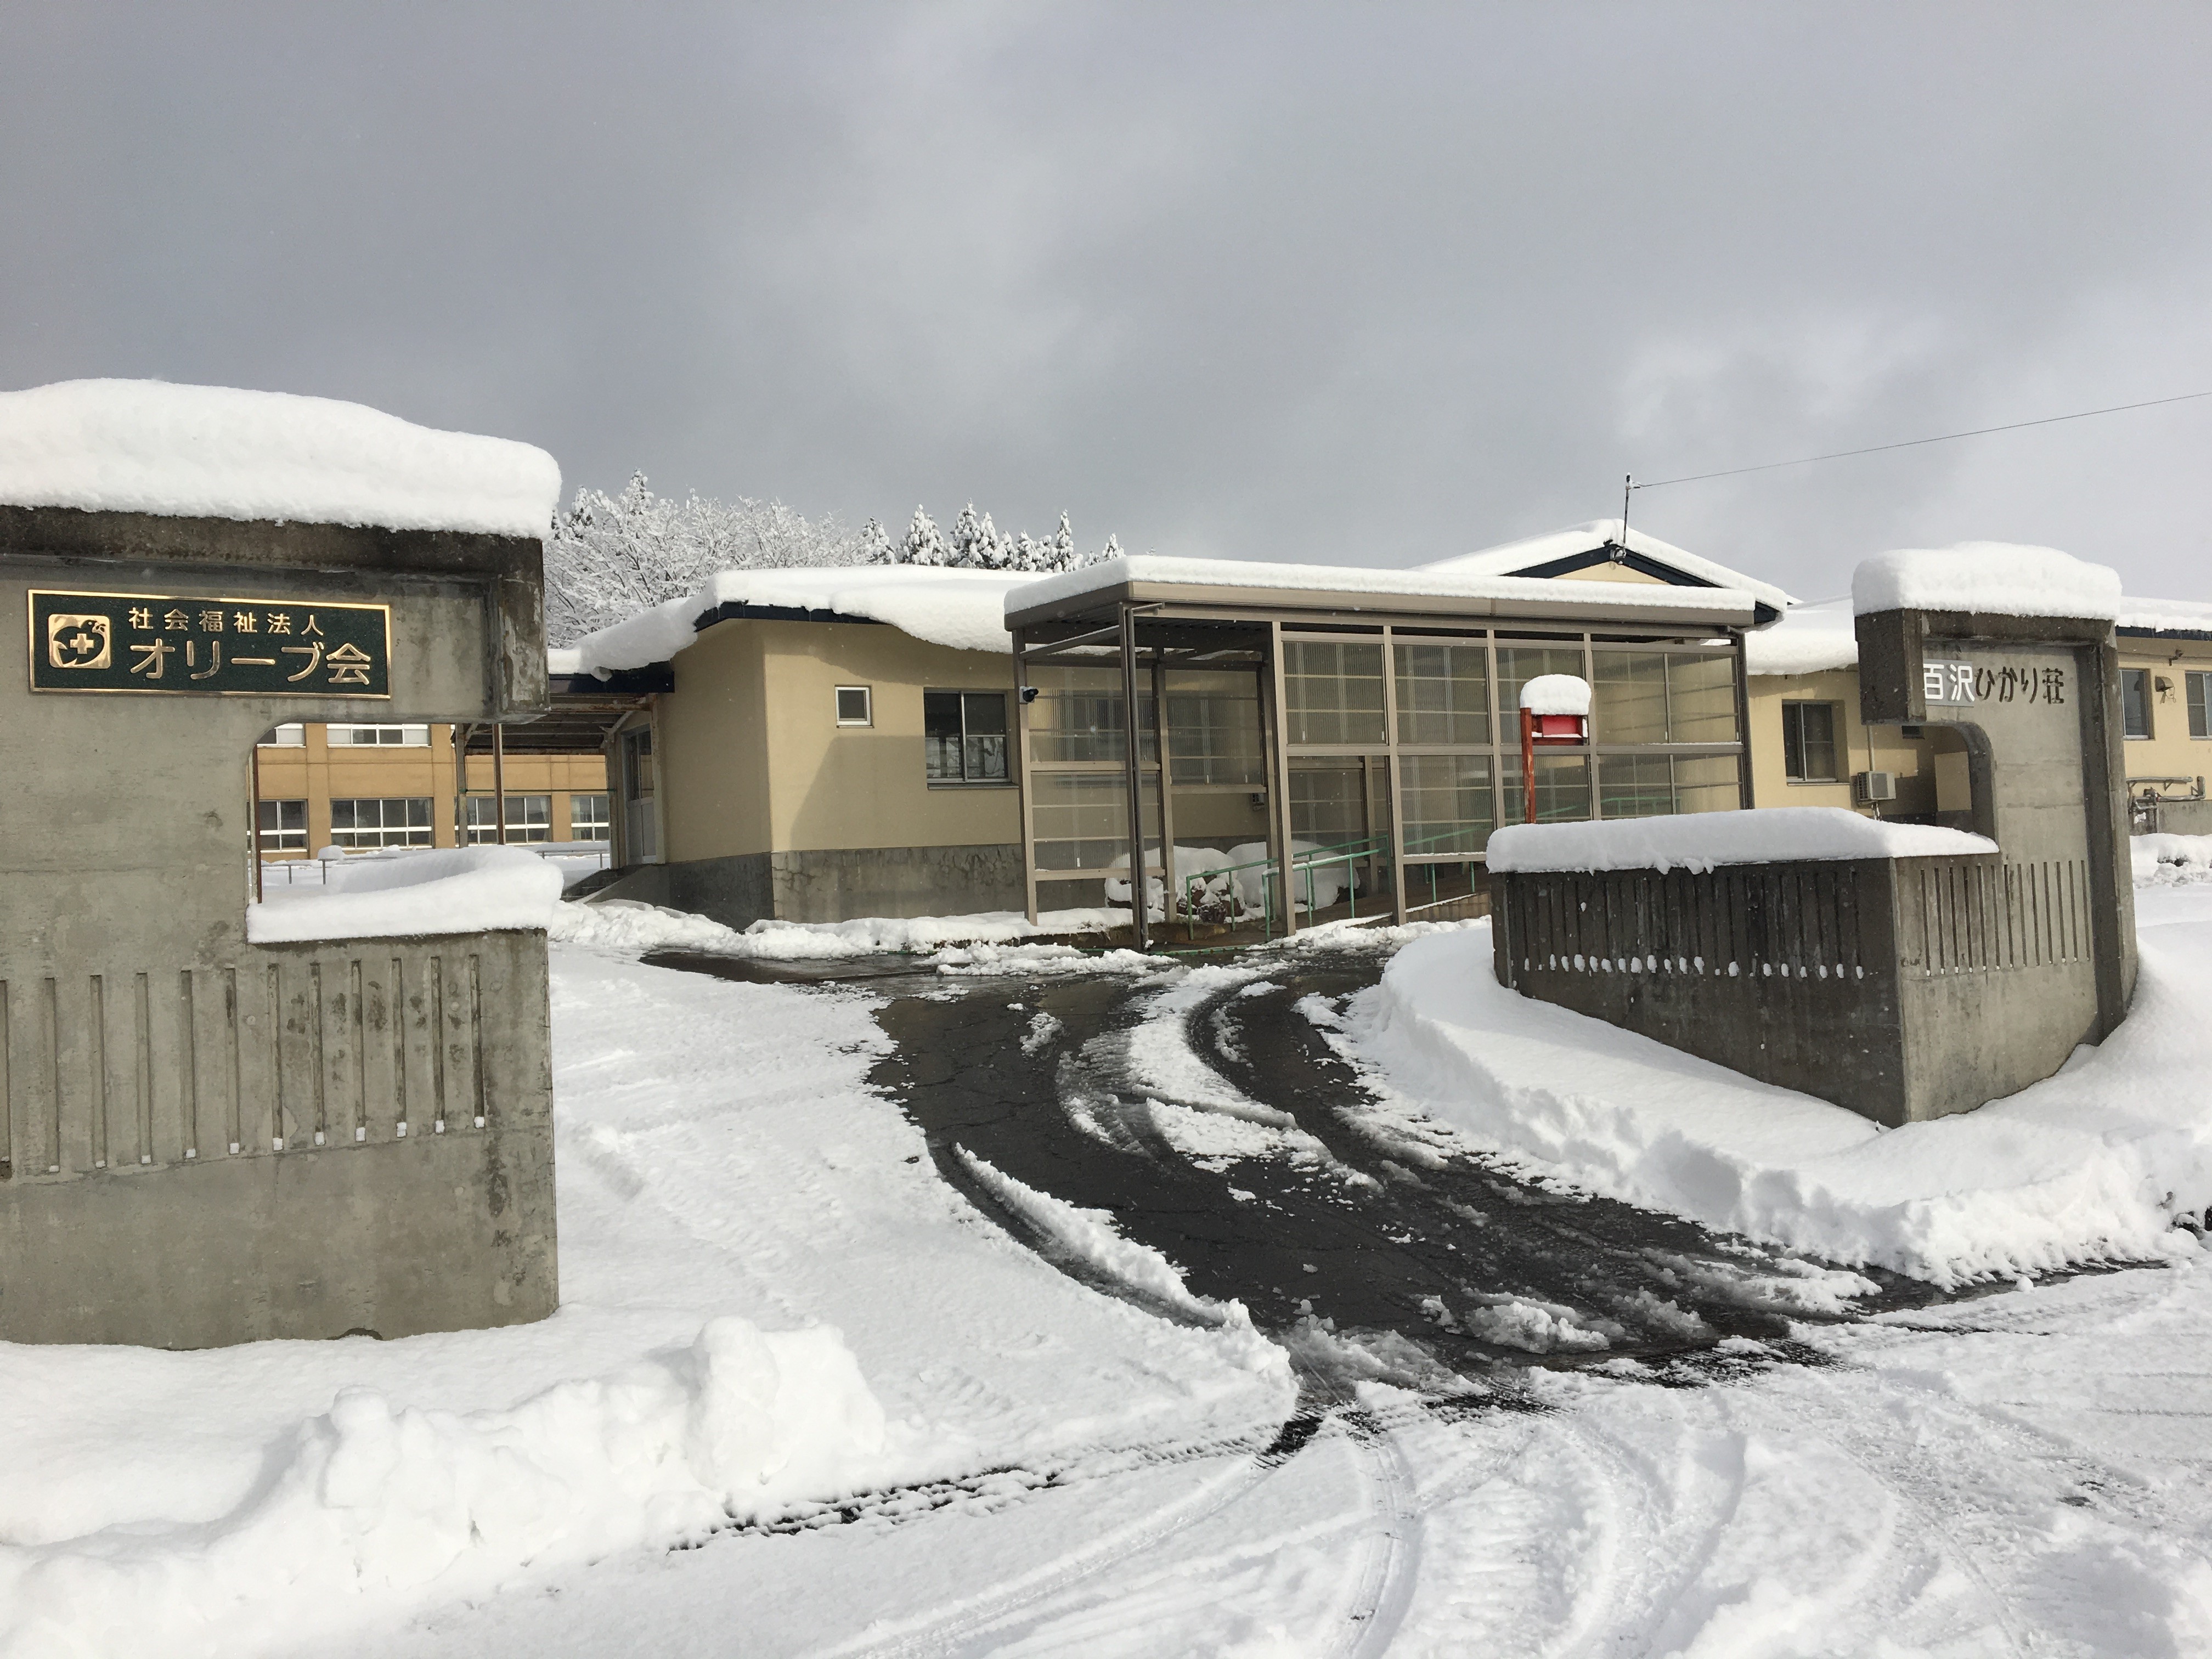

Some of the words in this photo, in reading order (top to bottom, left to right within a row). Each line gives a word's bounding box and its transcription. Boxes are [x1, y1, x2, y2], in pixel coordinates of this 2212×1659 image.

[128, 607, 324, 636] 社会福祉法人
[129, 637, 371, 685] オリーブ会
